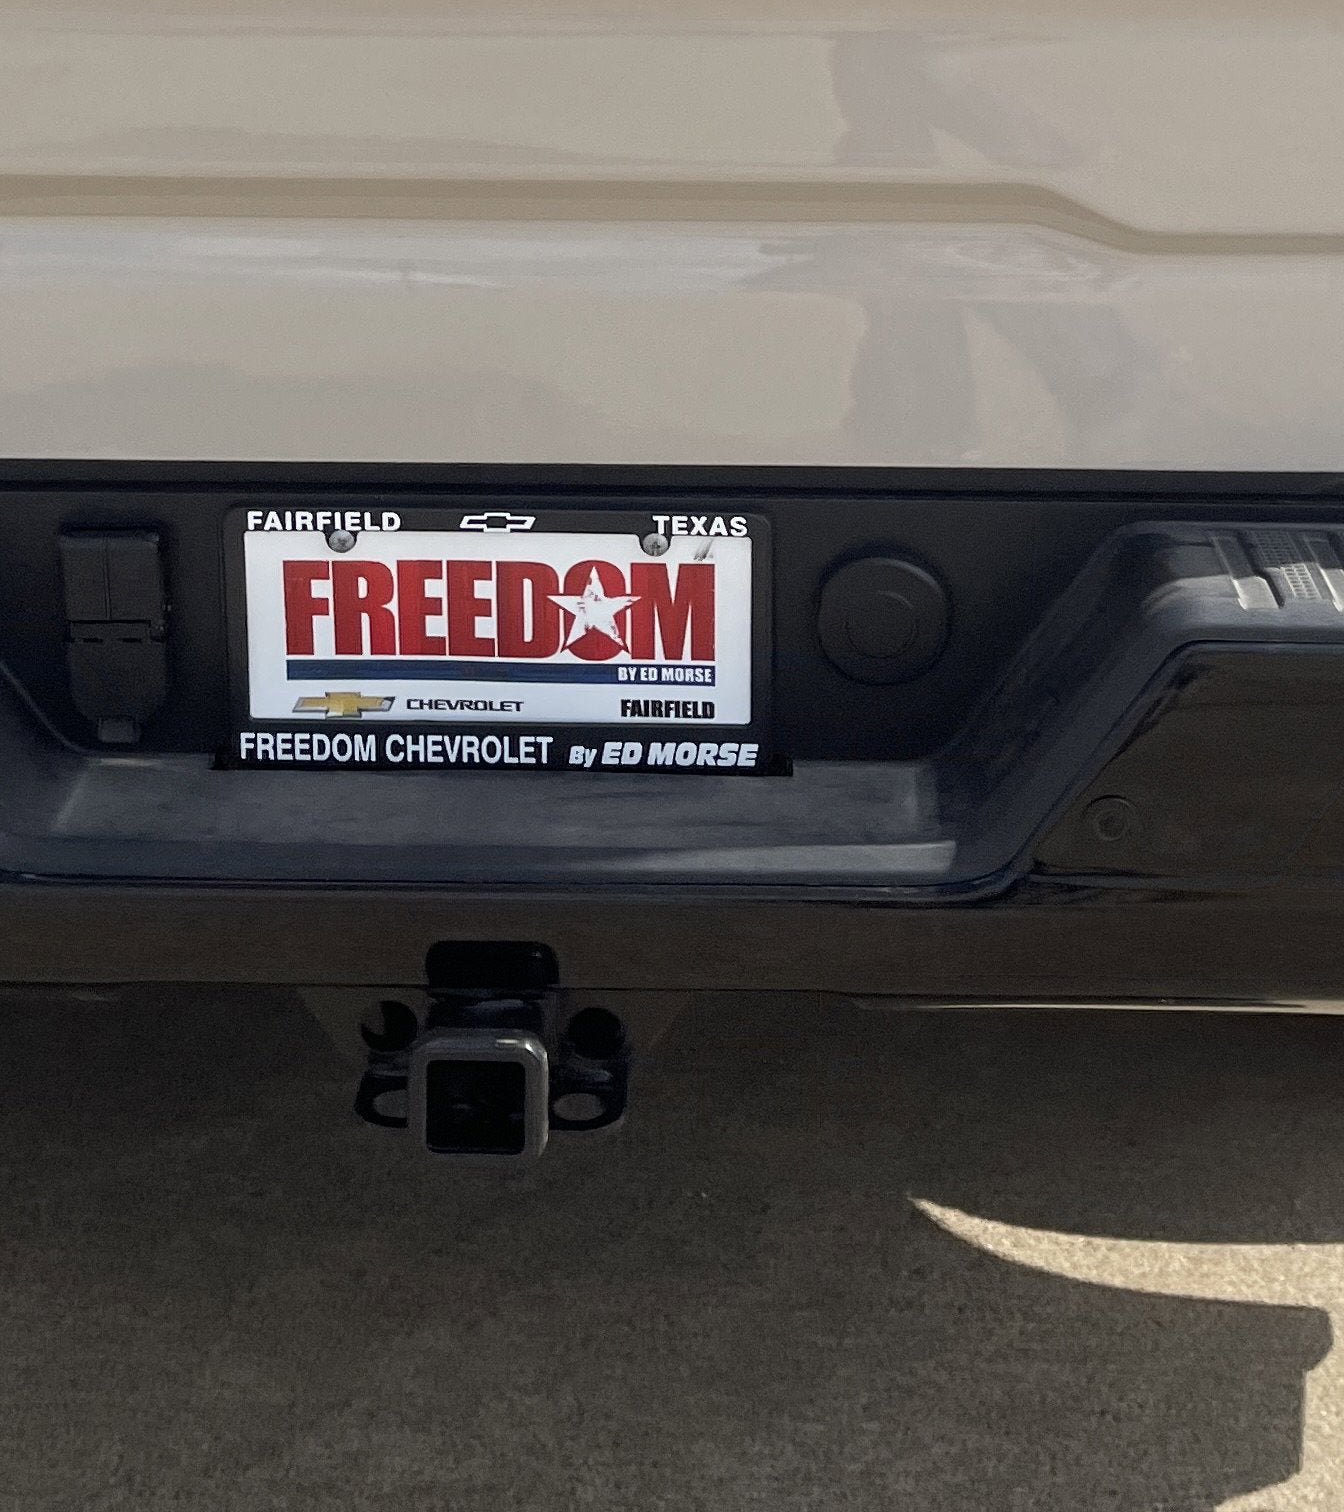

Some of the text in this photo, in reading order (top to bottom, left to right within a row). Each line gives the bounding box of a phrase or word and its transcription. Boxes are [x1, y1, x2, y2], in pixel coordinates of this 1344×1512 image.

[247, 511, 401, 532] FAIRFIELD
[652, 515, 748, 536] TEXAS
[282, 559, 716, 662] FREEDOM
[617, 666, 713, 683] BY ED MORSE
[406, 698, 524, 713] CHEVROLET
[621, 699, 715, 719] FAIRFIELD
[240, 732, 759, 768] FREEDOM CHEVROLET By ED MORSE
